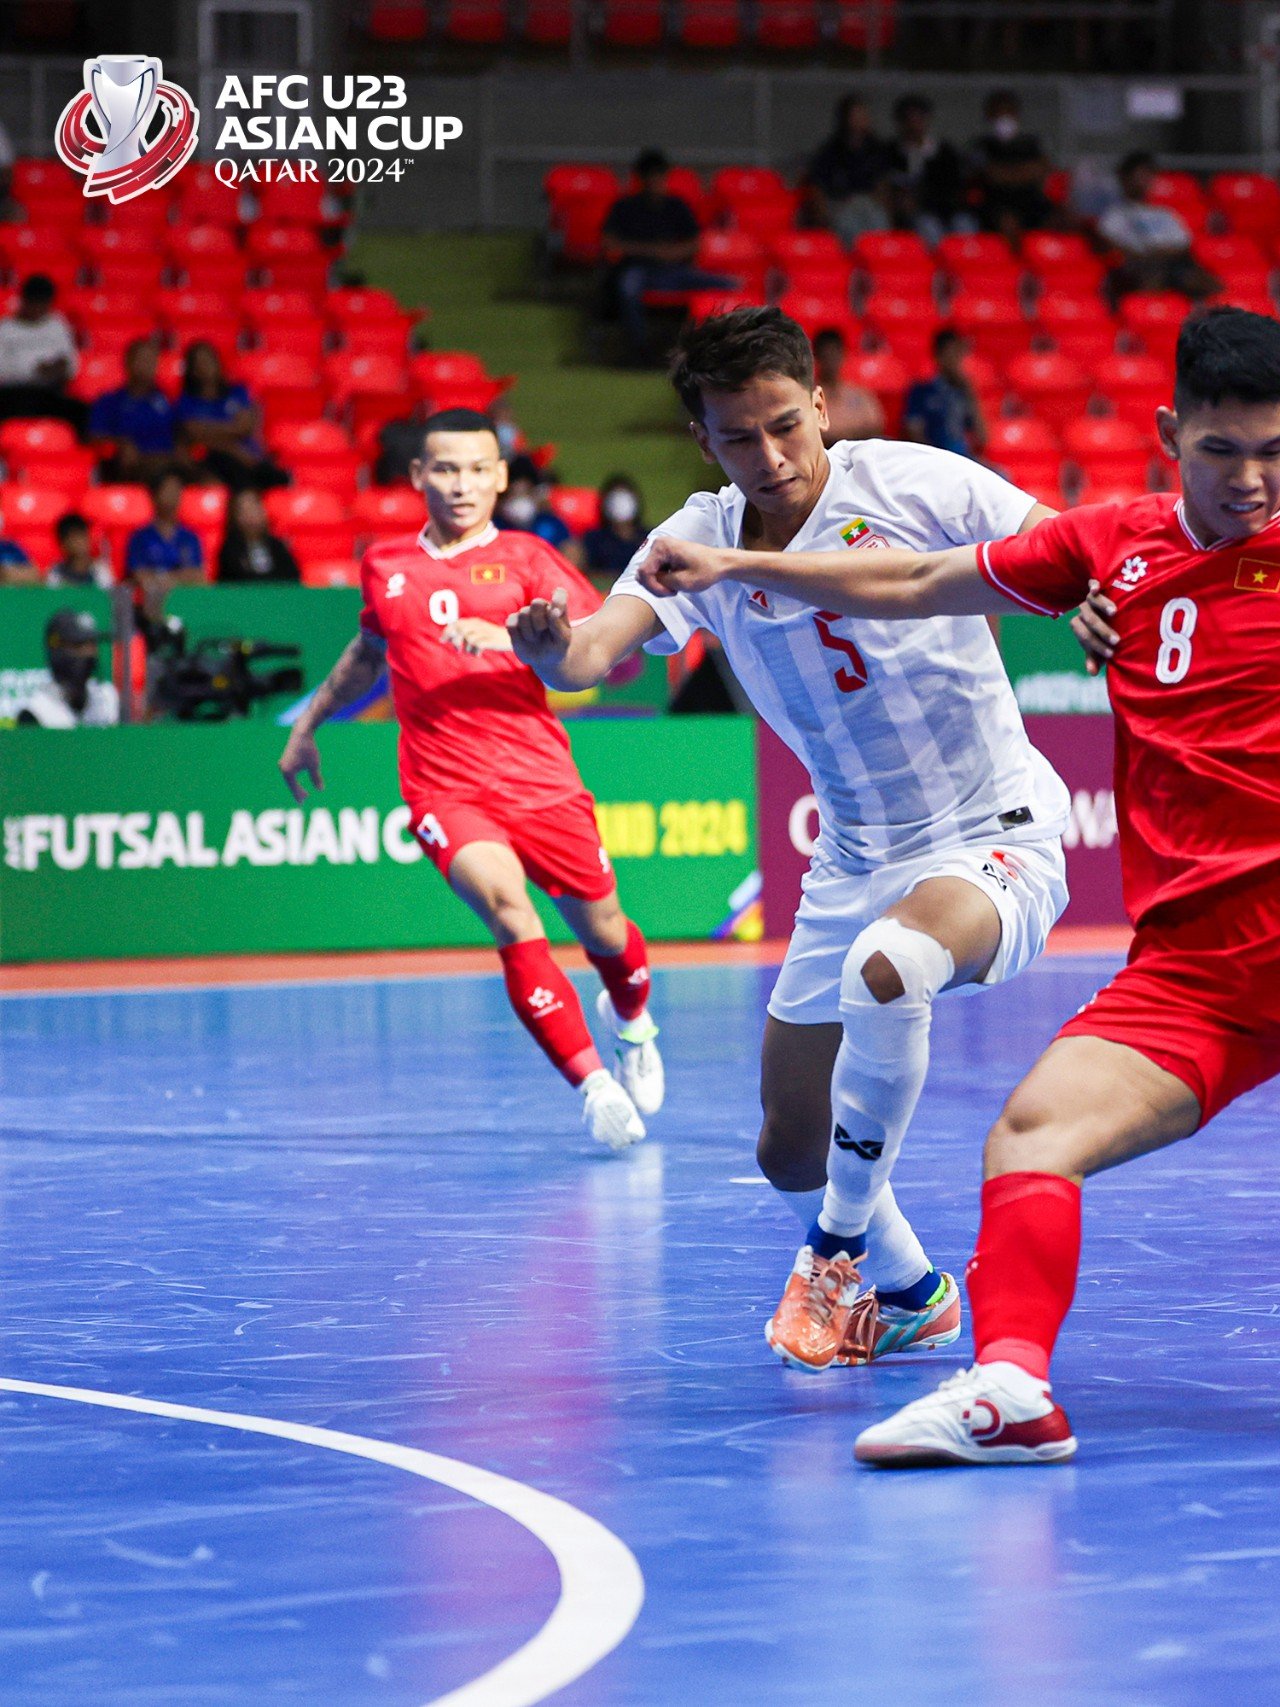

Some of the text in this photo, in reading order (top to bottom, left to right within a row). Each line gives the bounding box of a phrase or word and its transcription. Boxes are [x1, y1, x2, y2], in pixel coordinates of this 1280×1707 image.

[812, 610, 868, 693] 5
[1155, 597, 1198, 684] 8
[24, 810, 218, 871] FUTSAL
[221, 806, 380, 867] ASIAN
